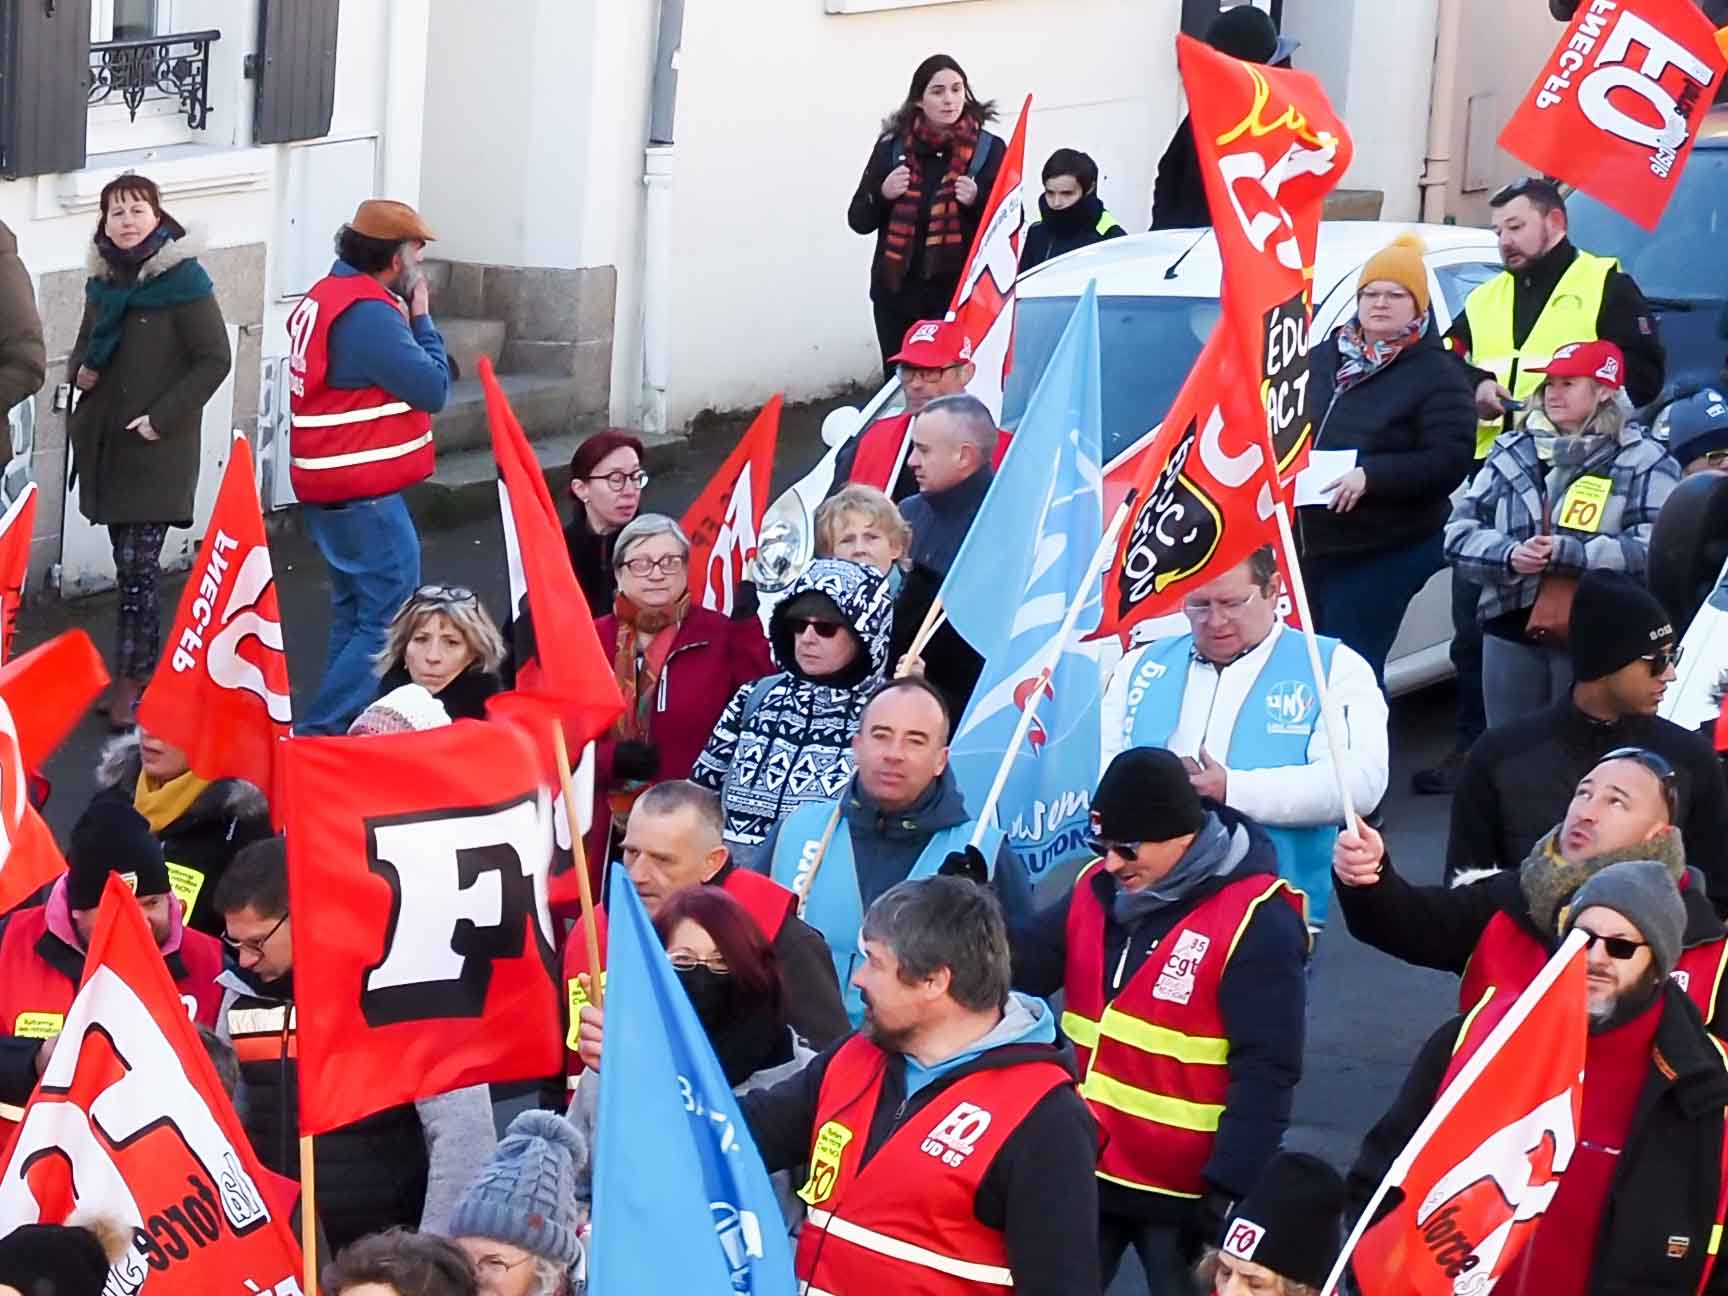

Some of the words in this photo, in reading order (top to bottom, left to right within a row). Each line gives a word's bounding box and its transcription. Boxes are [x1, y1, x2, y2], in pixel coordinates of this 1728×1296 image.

[1564, 499, 1597, 527] FO
[1168, 955, 1199, 977] cgt
[928, 1102, 992, 1151] FO
[1226, 1223, 1256, 1253] FO
